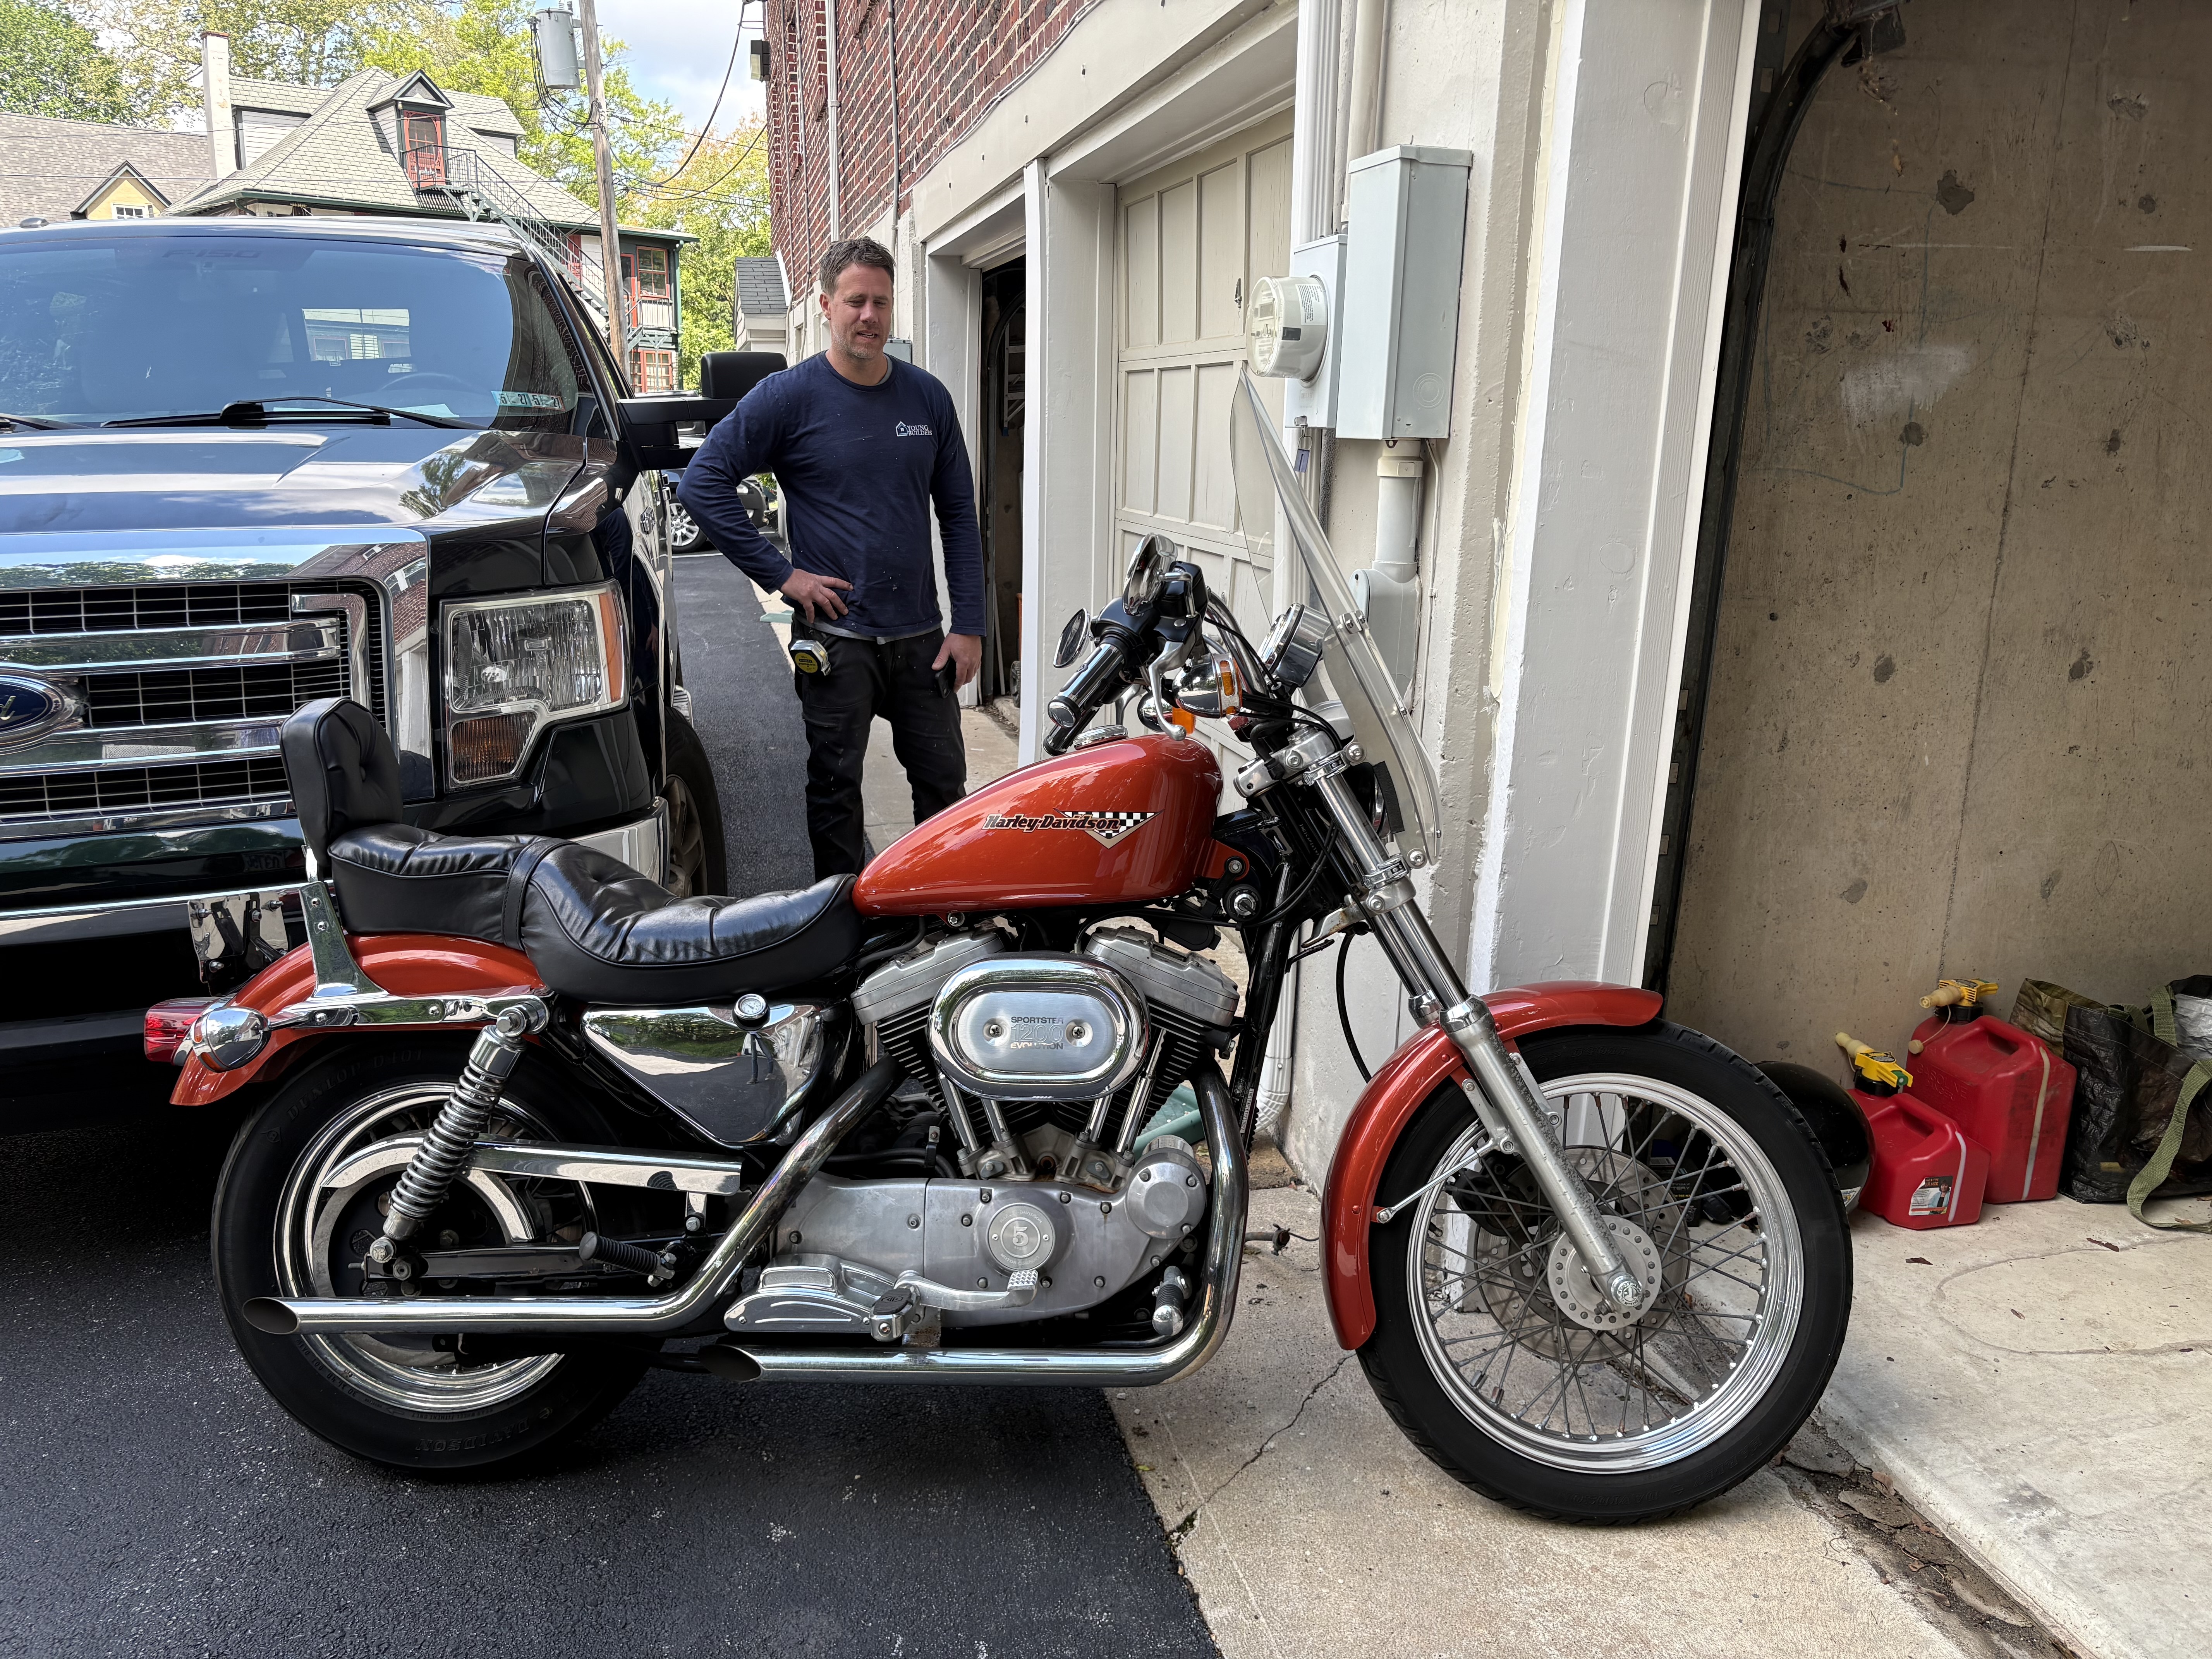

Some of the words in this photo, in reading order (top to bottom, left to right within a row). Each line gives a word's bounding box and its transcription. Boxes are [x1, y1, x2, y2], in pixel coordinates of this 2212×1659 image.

[162, 248, 262, 258] F-150
[531, 394, 541, 405] 5
[551, 396, 560, 408] 27
[1011, 1016, 1064, 1024] SPORTSTER
[1011, 1023, 1063, 1043] 1200
[1010, 1042, 1063, 1050] EVOLUTION
[1917, 1063, 1968, 1099] GASOLNE
[286, 1062, 361, 1121] DUNLOP
[1000, 1209, 1042, 1224] HARLE-DAVIDSON
[1012, 1226, 1029, 1247] 5
[1000, 1253, 1017, 1265] MOTOR
[415, 1417, 530, 1452] DAVIDSON
